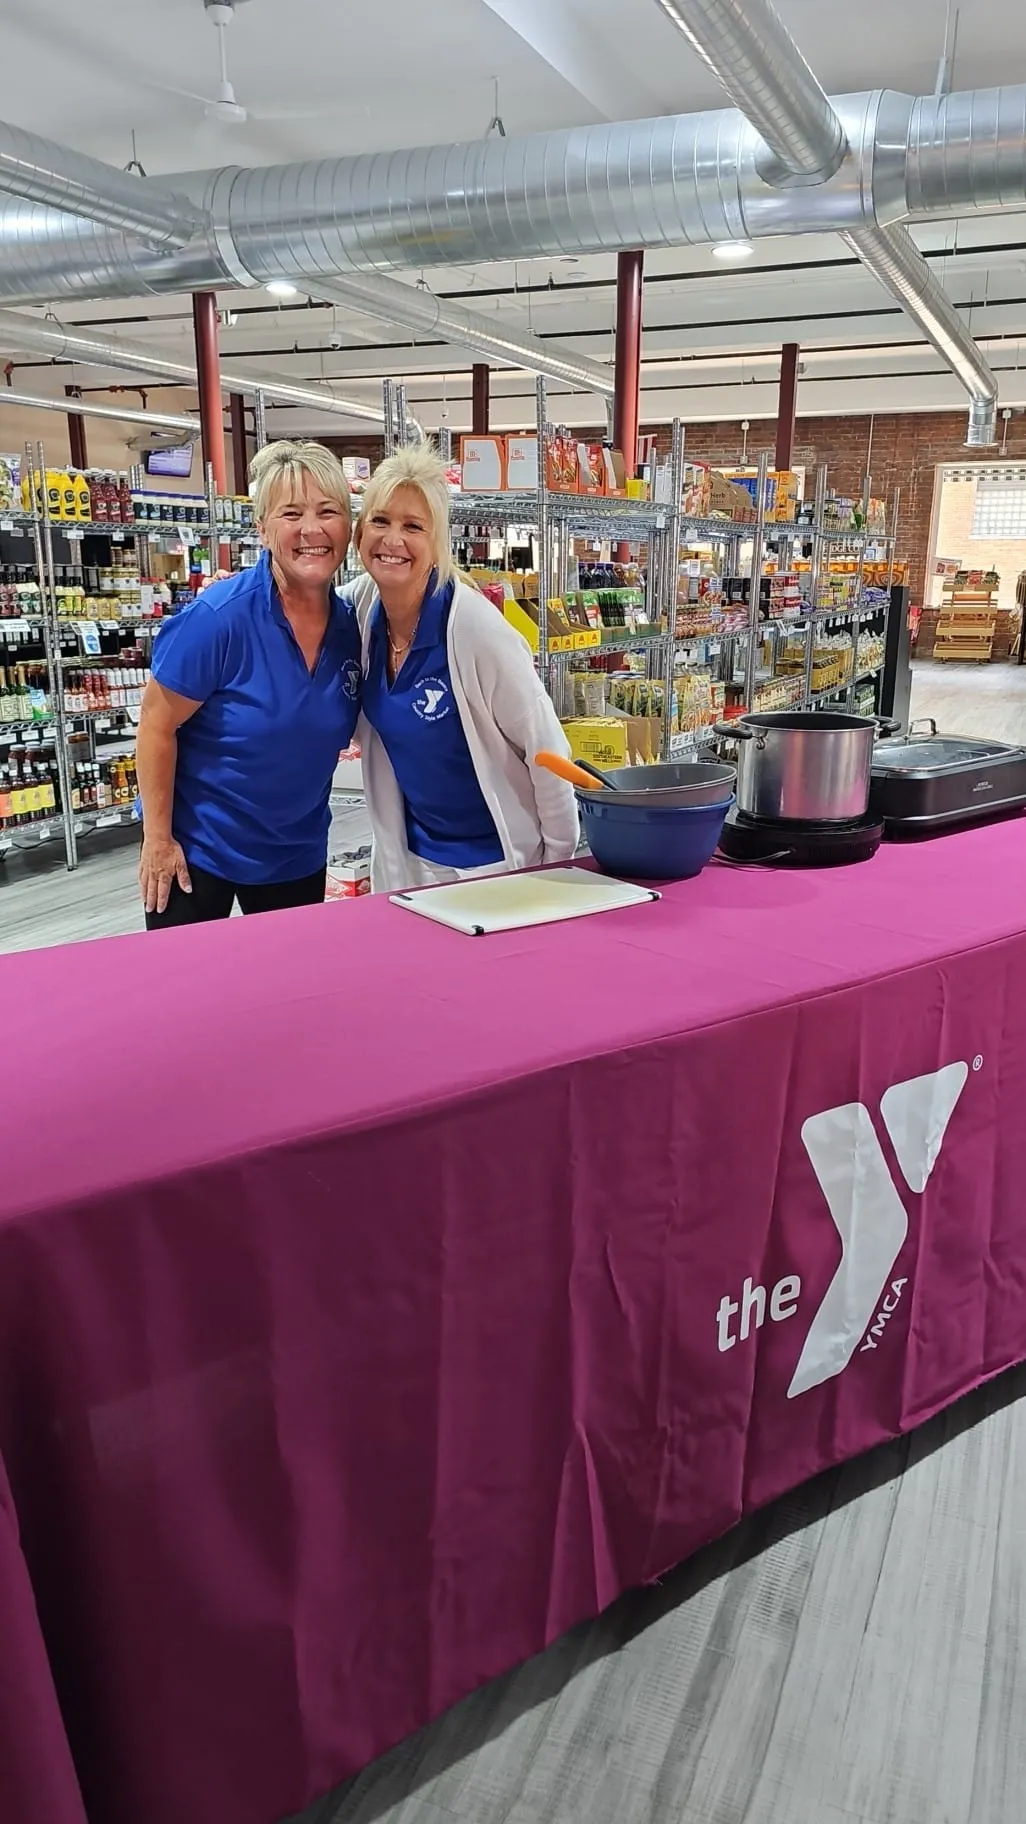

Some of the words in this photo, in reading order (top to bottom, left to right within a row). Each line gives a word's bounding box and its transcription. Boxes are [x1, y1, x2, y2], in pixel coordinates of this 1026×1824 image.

[716, 1274, 801, 1352] the
[787, 1060, 969, 1399] Y
[860, 1277, 908, 1352] YMCA
